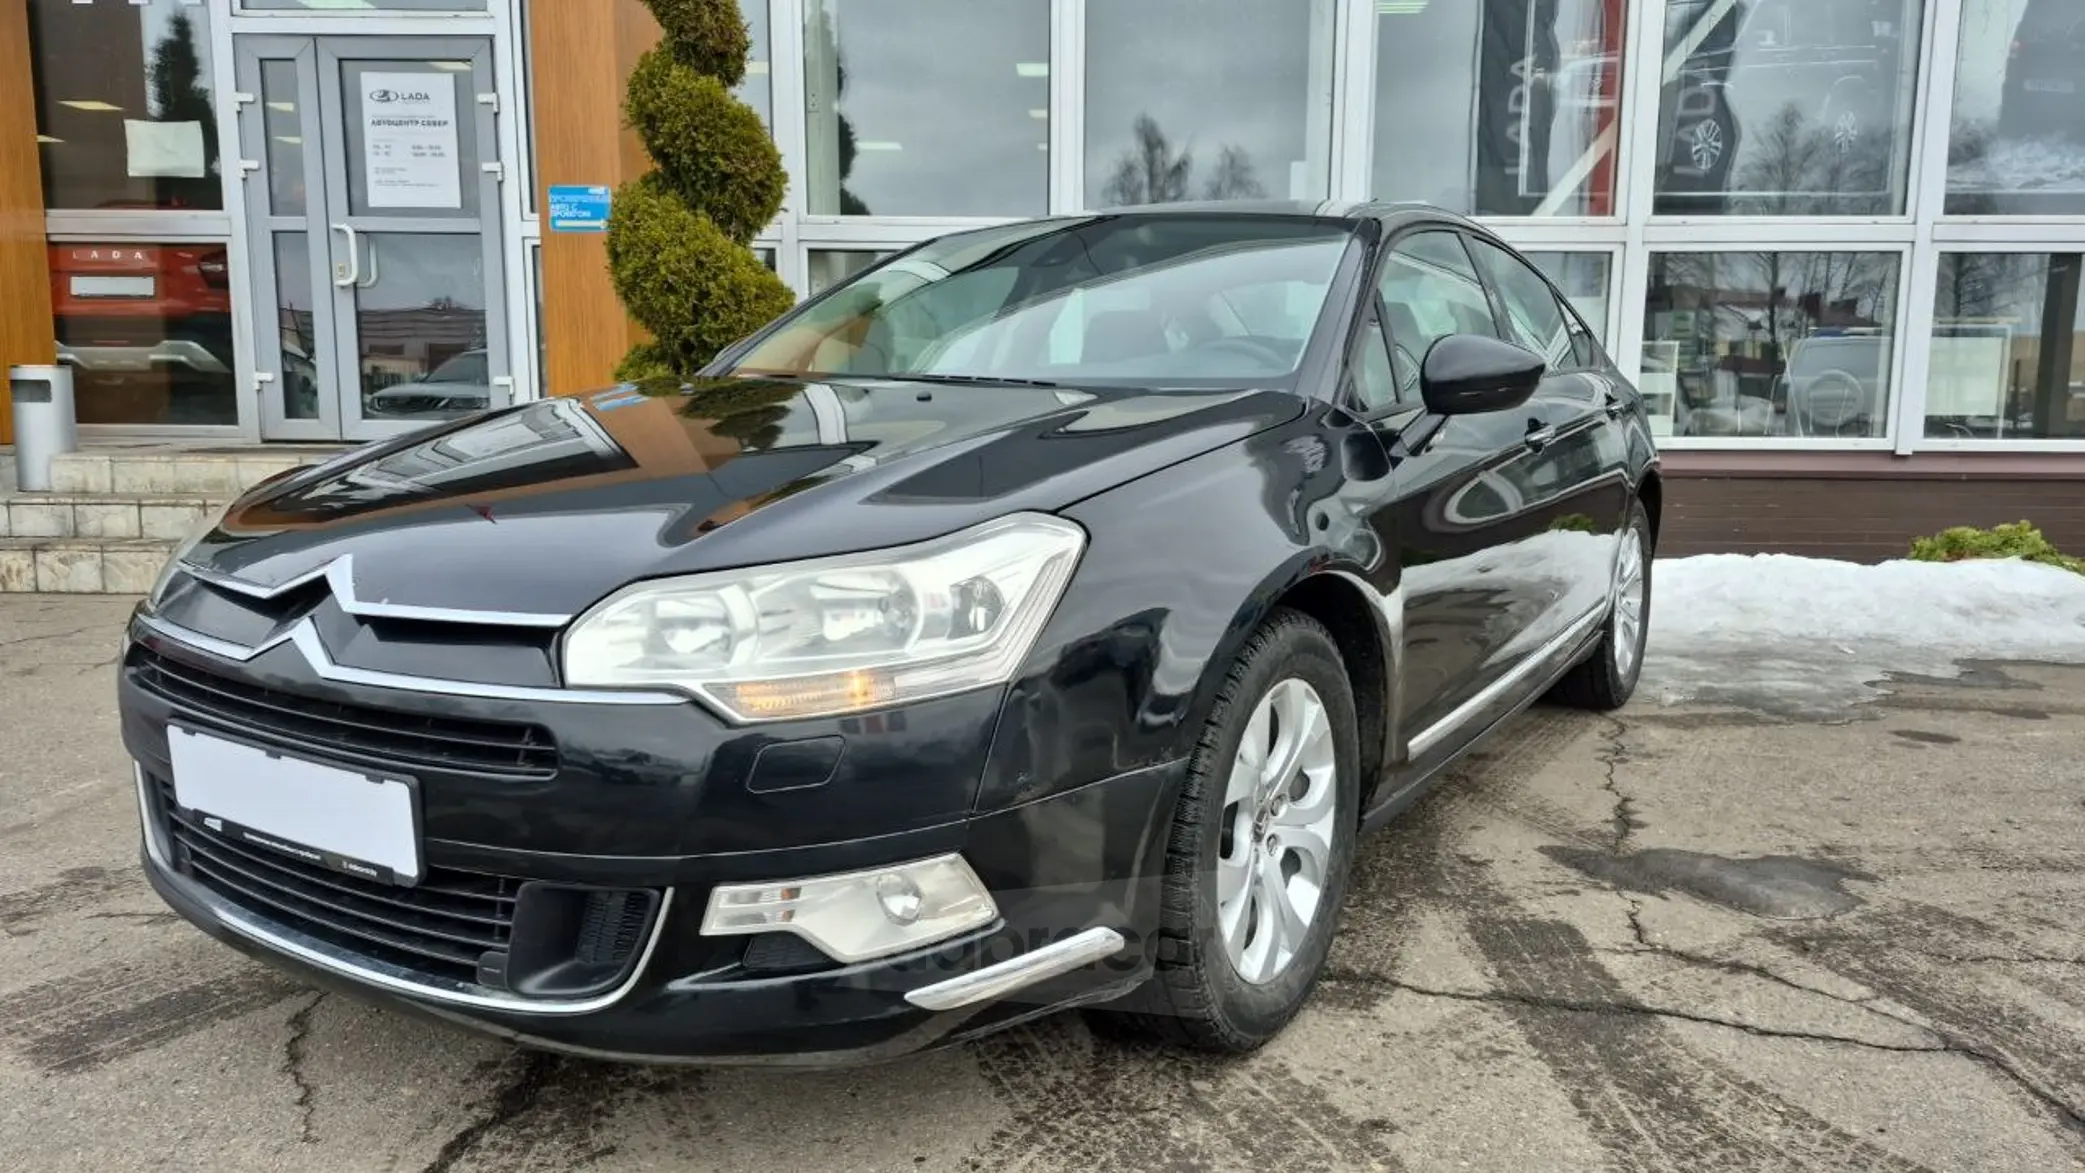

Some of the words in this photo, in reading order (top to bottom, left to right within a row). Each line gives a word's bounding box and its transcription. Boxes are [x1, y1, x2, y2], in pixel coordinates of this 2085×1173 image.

[401, 92, 430, 101] LADA
[371, 119, 419, 127] АВТОЦЕНТР
[421, 119, 449, 127] СЕВЕР
[72, 250, 143, 260] LADA
